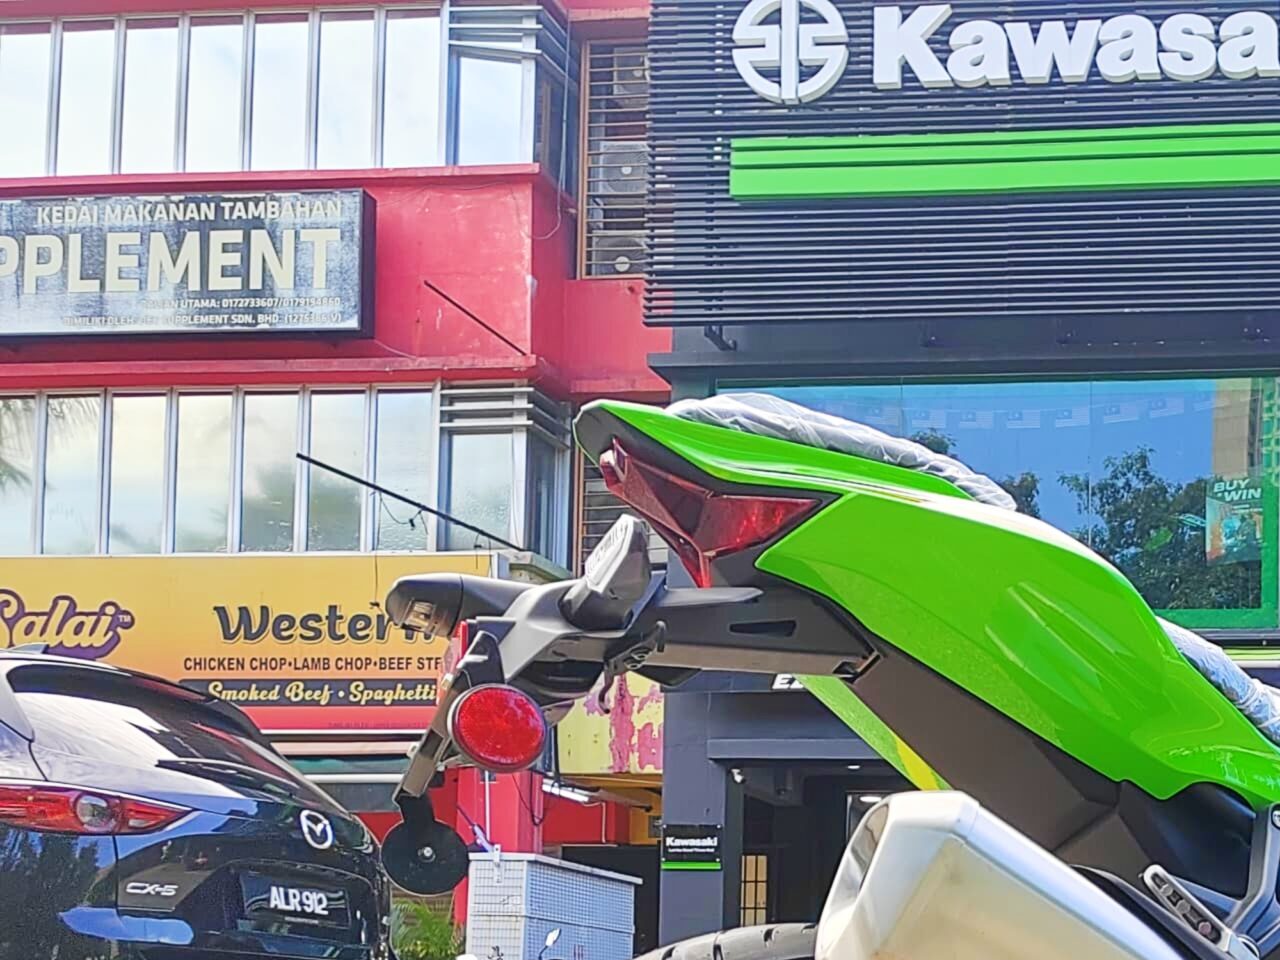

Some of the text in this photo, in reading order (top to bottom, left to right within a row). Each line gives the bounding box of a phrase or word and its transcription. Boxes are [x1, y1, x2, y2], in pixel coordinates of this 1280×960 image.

[37, 201, 342, 224] KEDAI MAKANAN TAMBAHAN
[181, 298, 220, 309] UTAMA:
[1214, 478, 1250, 492] BUY
[1224, 488, 1261, 501] WIN
[184, 657, 245, 671] CHICKEN
[378, 657, 413, 671] BEEF
[208, 681, 437, 705] Smoked Beef Spaghetti
[126, 882, 178, 896] CX-5
[269, 886, 329, 915] ALR 912
